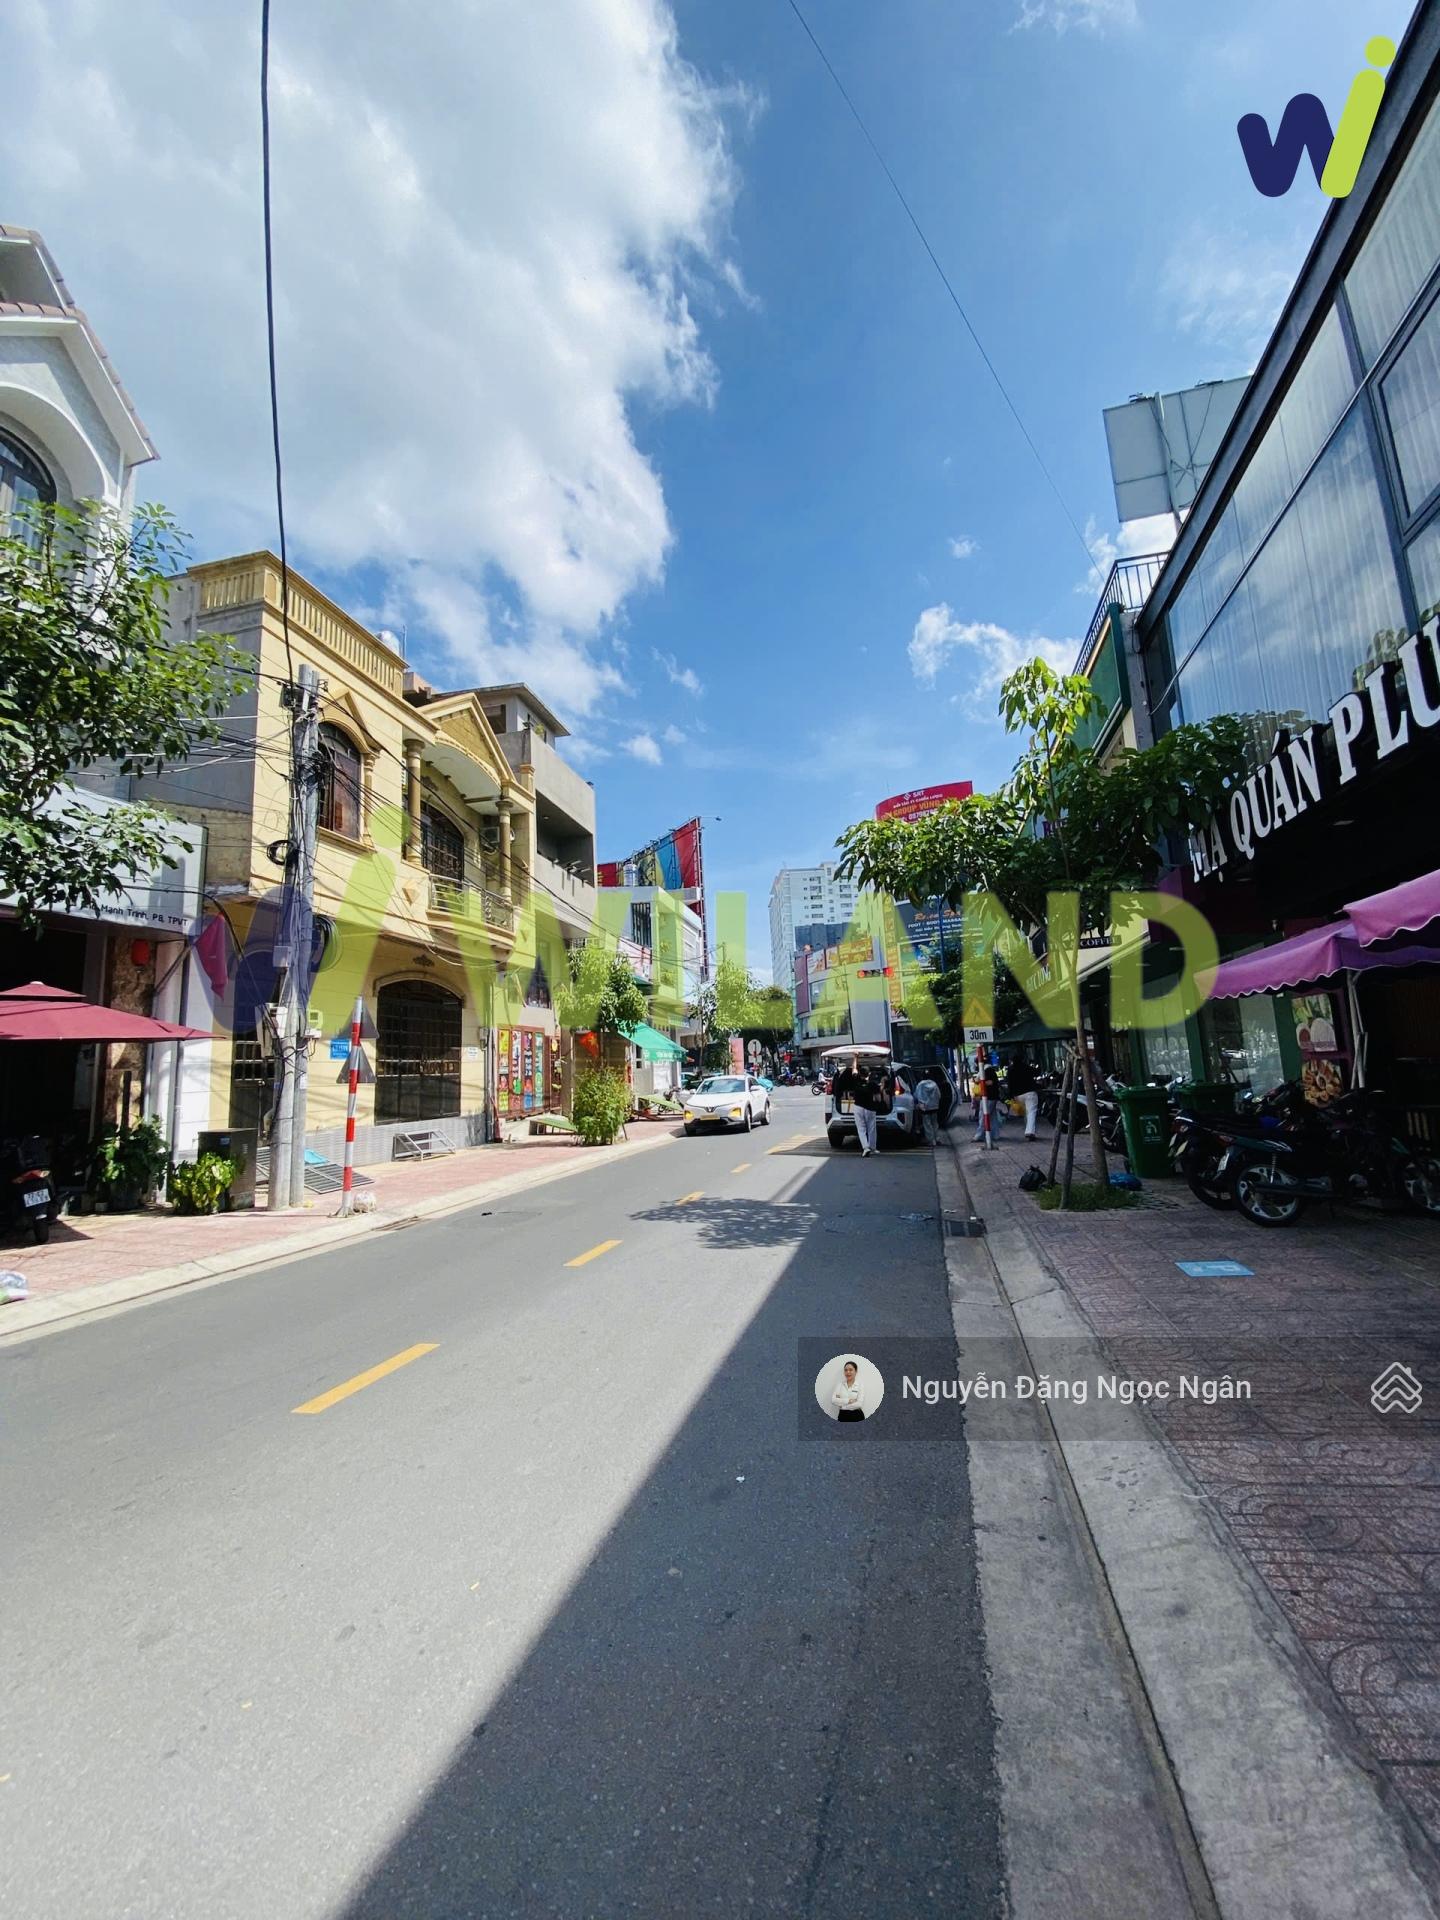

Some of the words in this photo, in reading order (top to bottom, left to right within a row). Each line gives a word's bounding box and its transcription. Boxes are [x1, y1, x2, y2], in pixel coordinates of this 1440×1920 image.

[1230, 729, 1322, 860] QUÁN
[168, 916, 188, 926] TPVT
[969, 1029, 988, 1041] 30m
